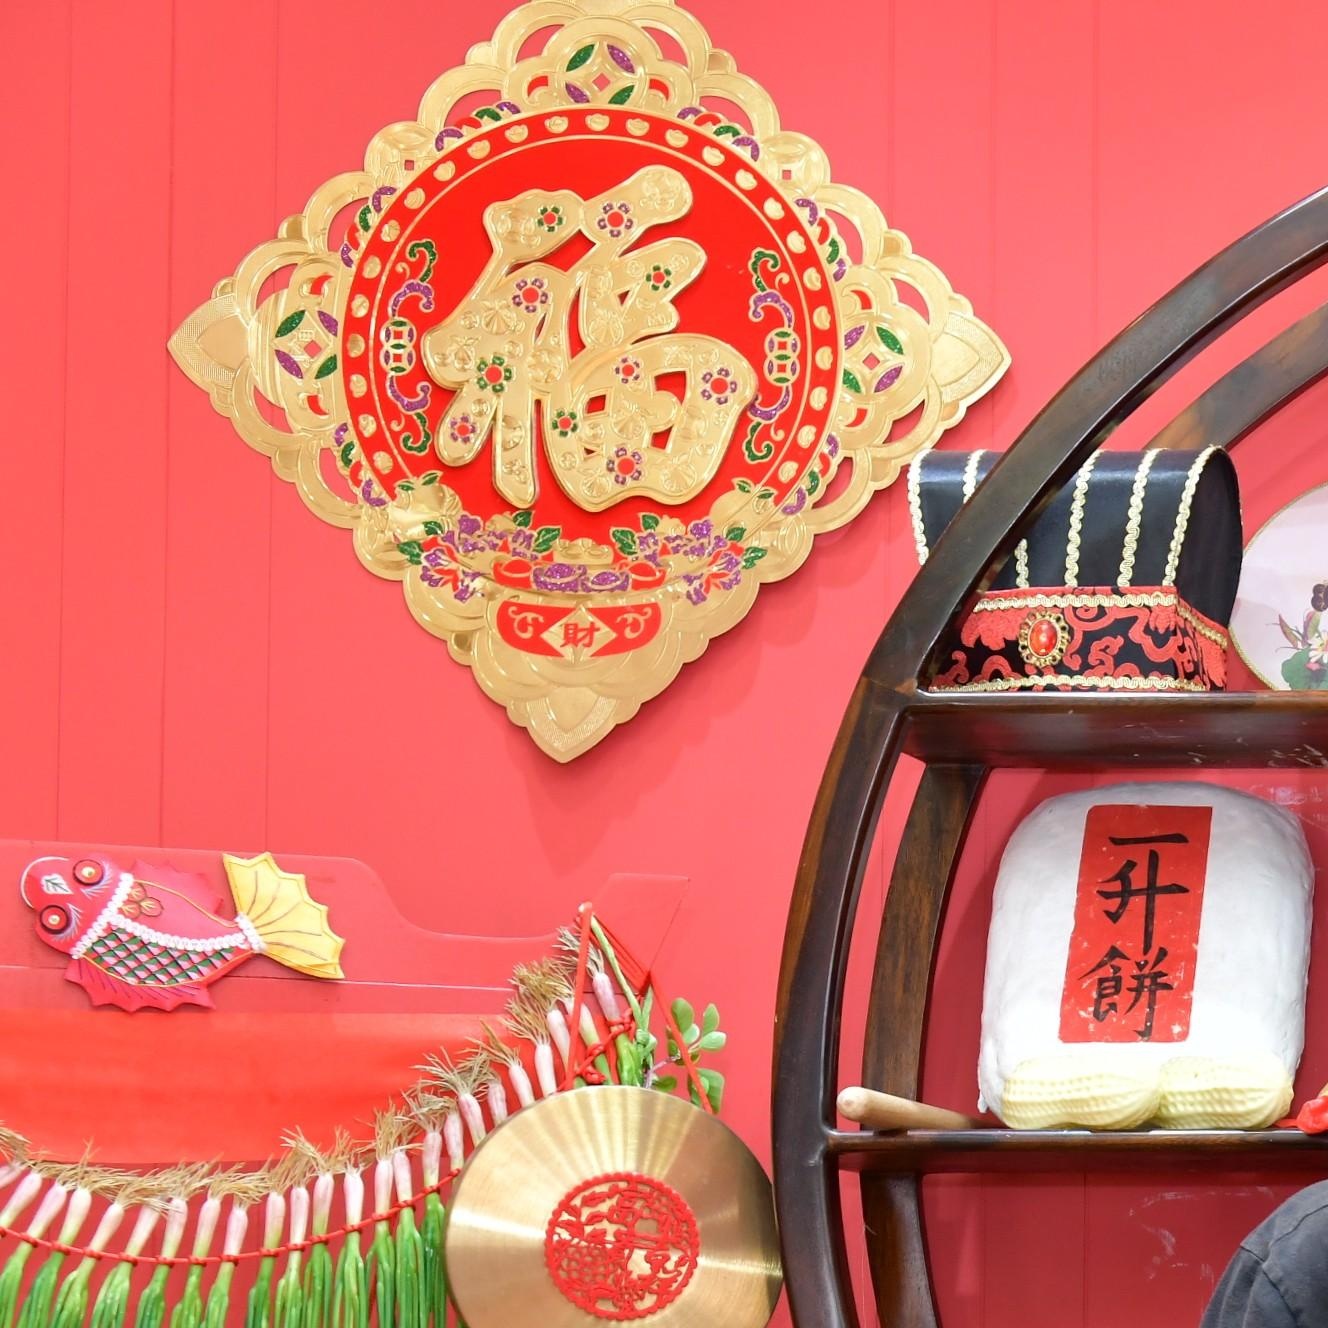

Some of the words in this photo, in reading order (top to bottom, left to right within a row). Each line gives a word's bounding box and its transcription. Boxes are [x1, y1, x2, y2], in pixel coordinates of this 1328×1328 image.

[423, 164, 758, 514] 福
[560, 621, 601, 648] 財
[1077, 832, 1191, 1041] 一升餅
